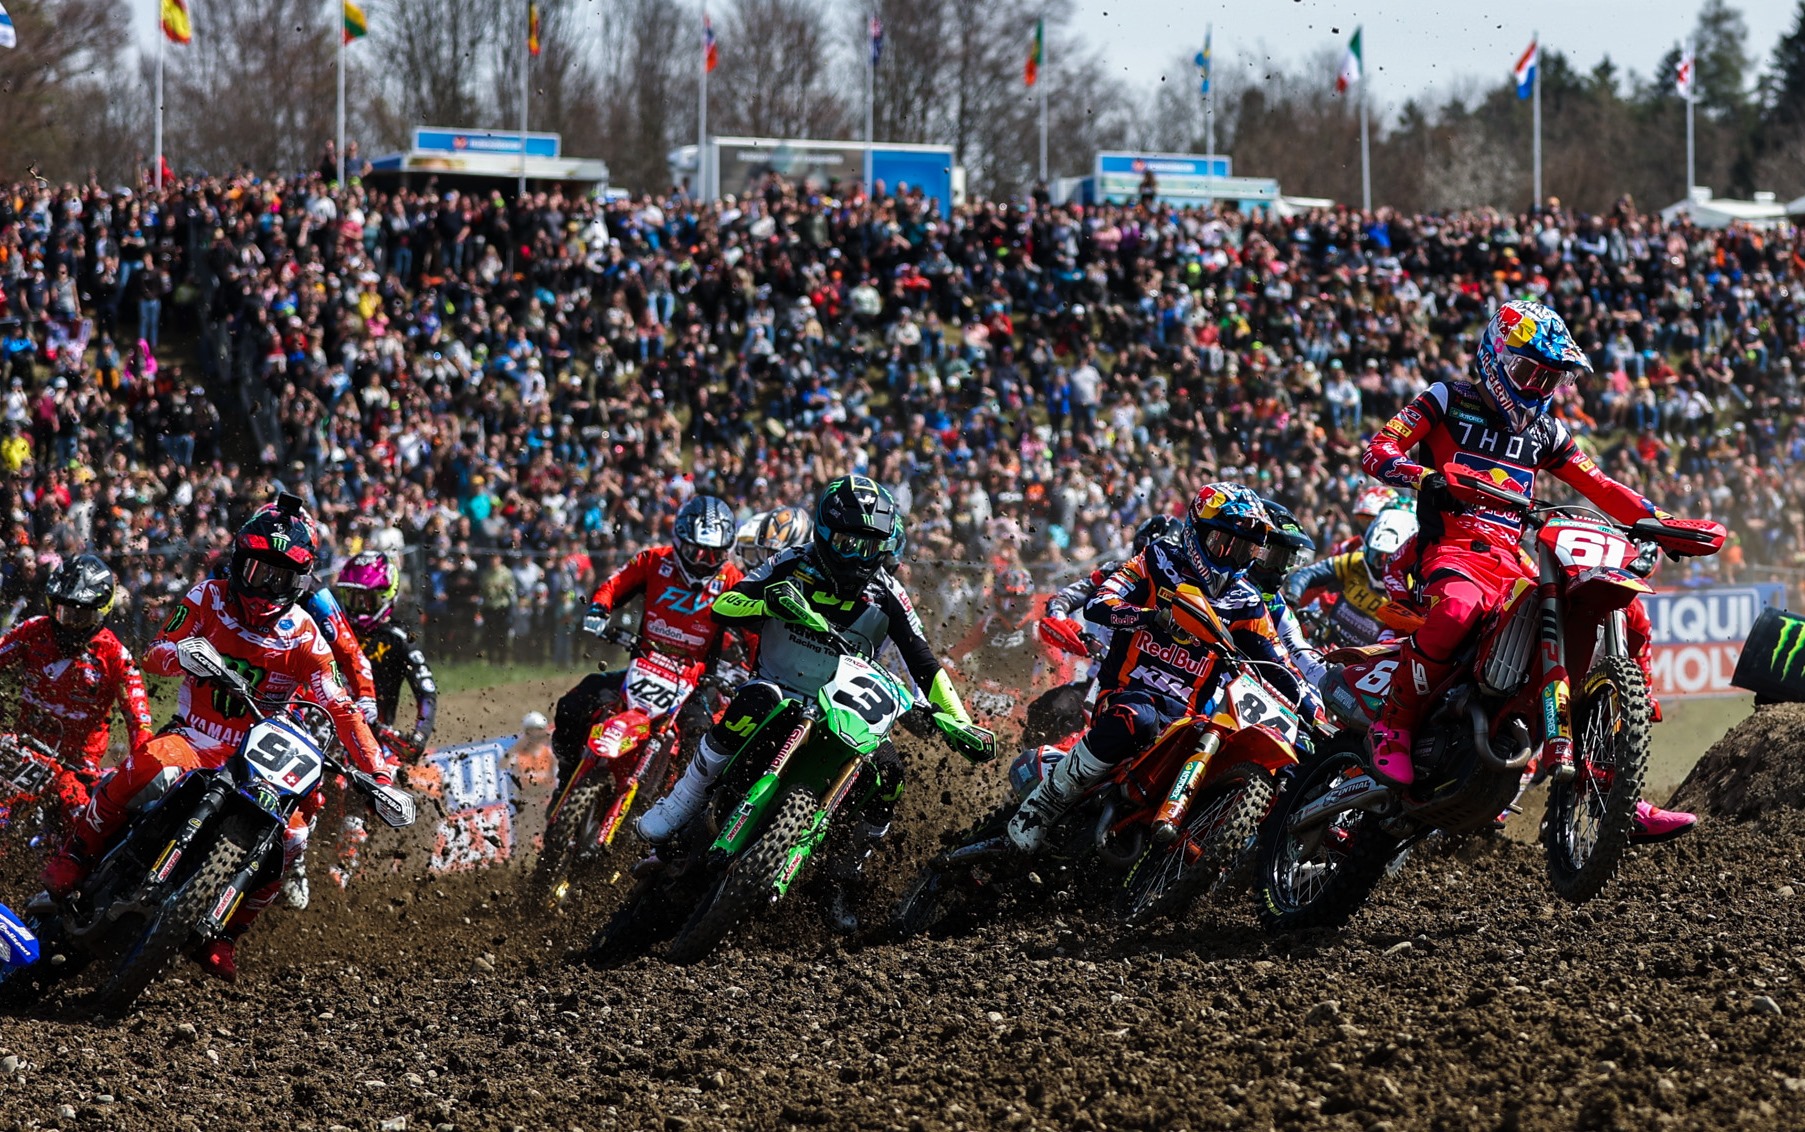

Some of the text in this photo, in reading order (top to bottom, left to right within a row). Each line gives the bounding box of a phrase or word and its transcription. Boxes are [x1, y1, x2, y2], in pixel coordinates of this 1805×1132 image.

[1493, 383, 1516, 412] Bull
[1555, 529, 1627, 569] 61
[655, 586, 716, 615] FLY
[1345, 581, 1381, 612] THO
[788, 633, 823, 654] Racing
[1136, 630, 1211, 678] Red Bull
[627, 677, 677, 710] 426
[1584, 671, 1608, 695] PIRELLI
[832, 676, 896, 725] 3
[1237, 692, 1292, 736] 84
[1545, 697, 1556, 734] MOTOREX
[190, 714, 246, 748] YAMAH
[246, 732, 319, 778] 91
[1169, 770, 1191, 800] MOTOREX
